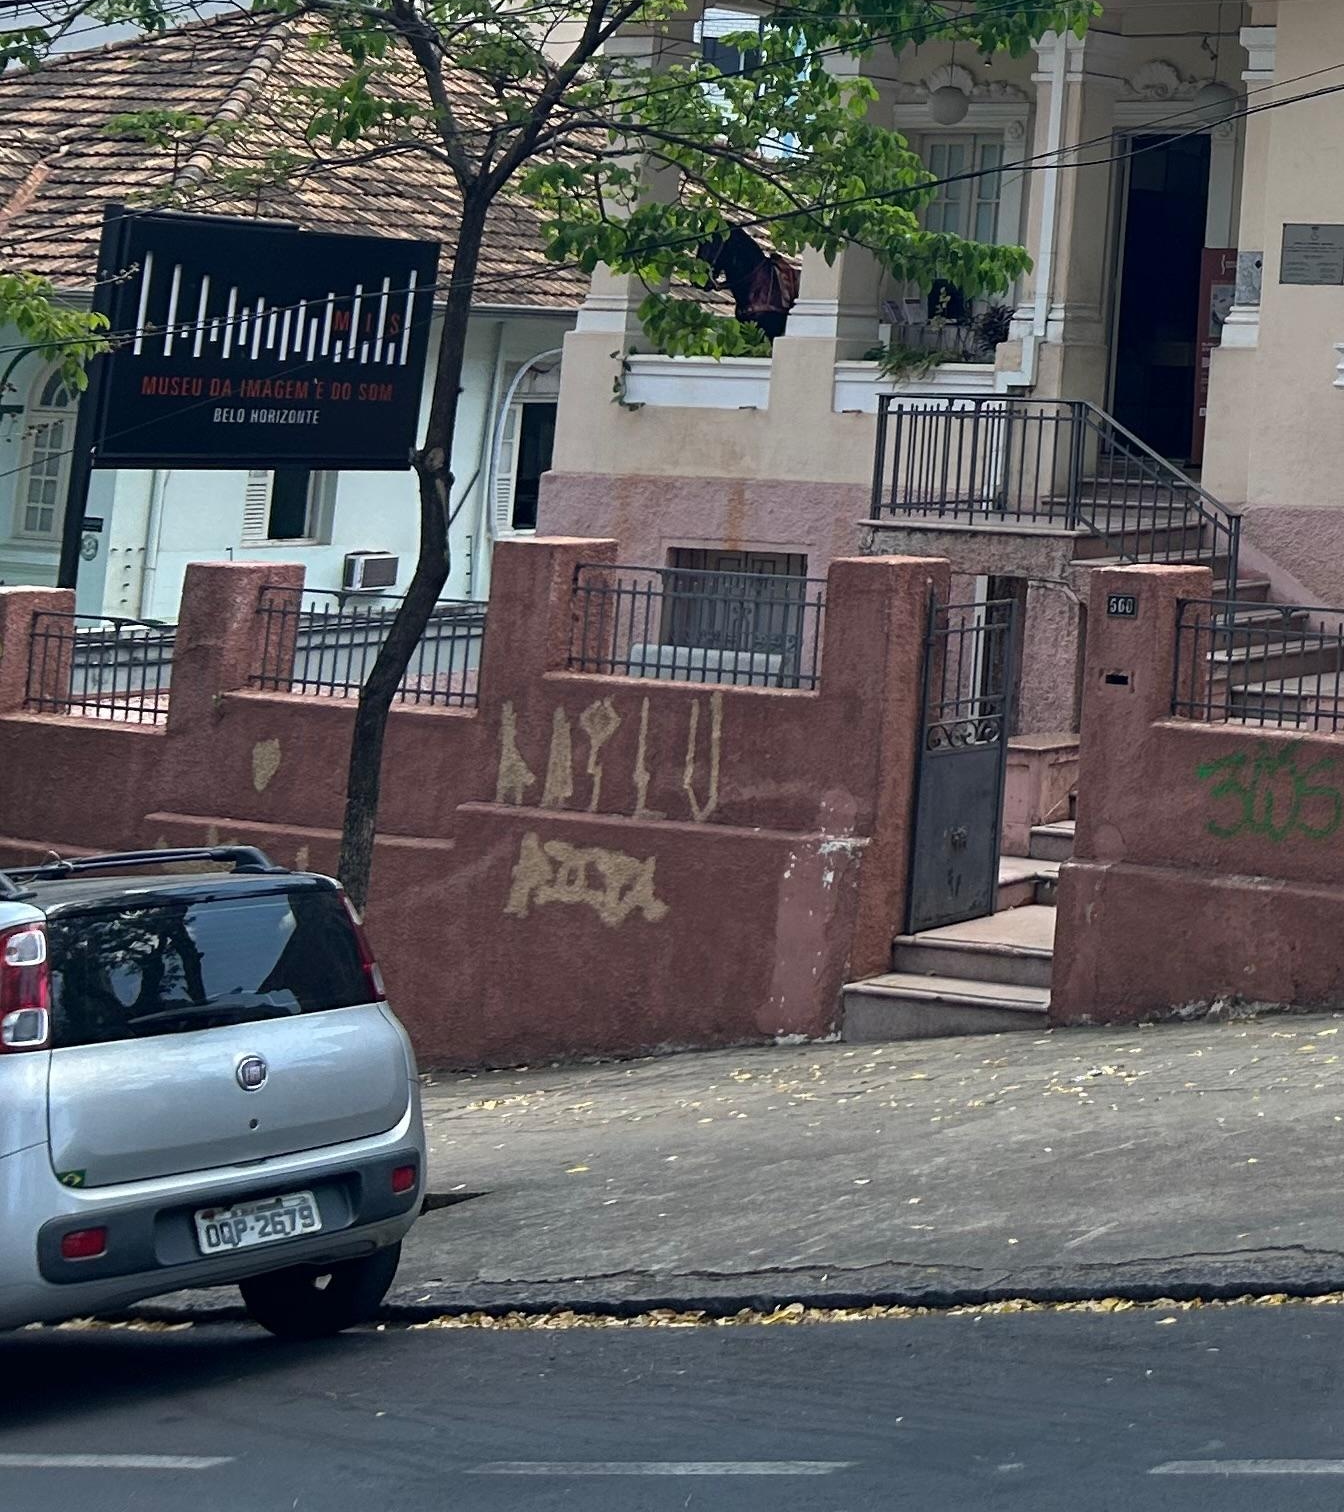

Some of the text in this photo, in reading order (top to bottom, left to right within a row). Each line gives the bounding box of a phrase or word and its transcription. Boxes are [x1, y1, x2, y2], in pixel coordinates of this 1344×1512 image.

[141, 376, 394, 402] MUSEU DA IMAGEM E DO SOM
[213, 407, 321, 425] BELO HORIZONTE
